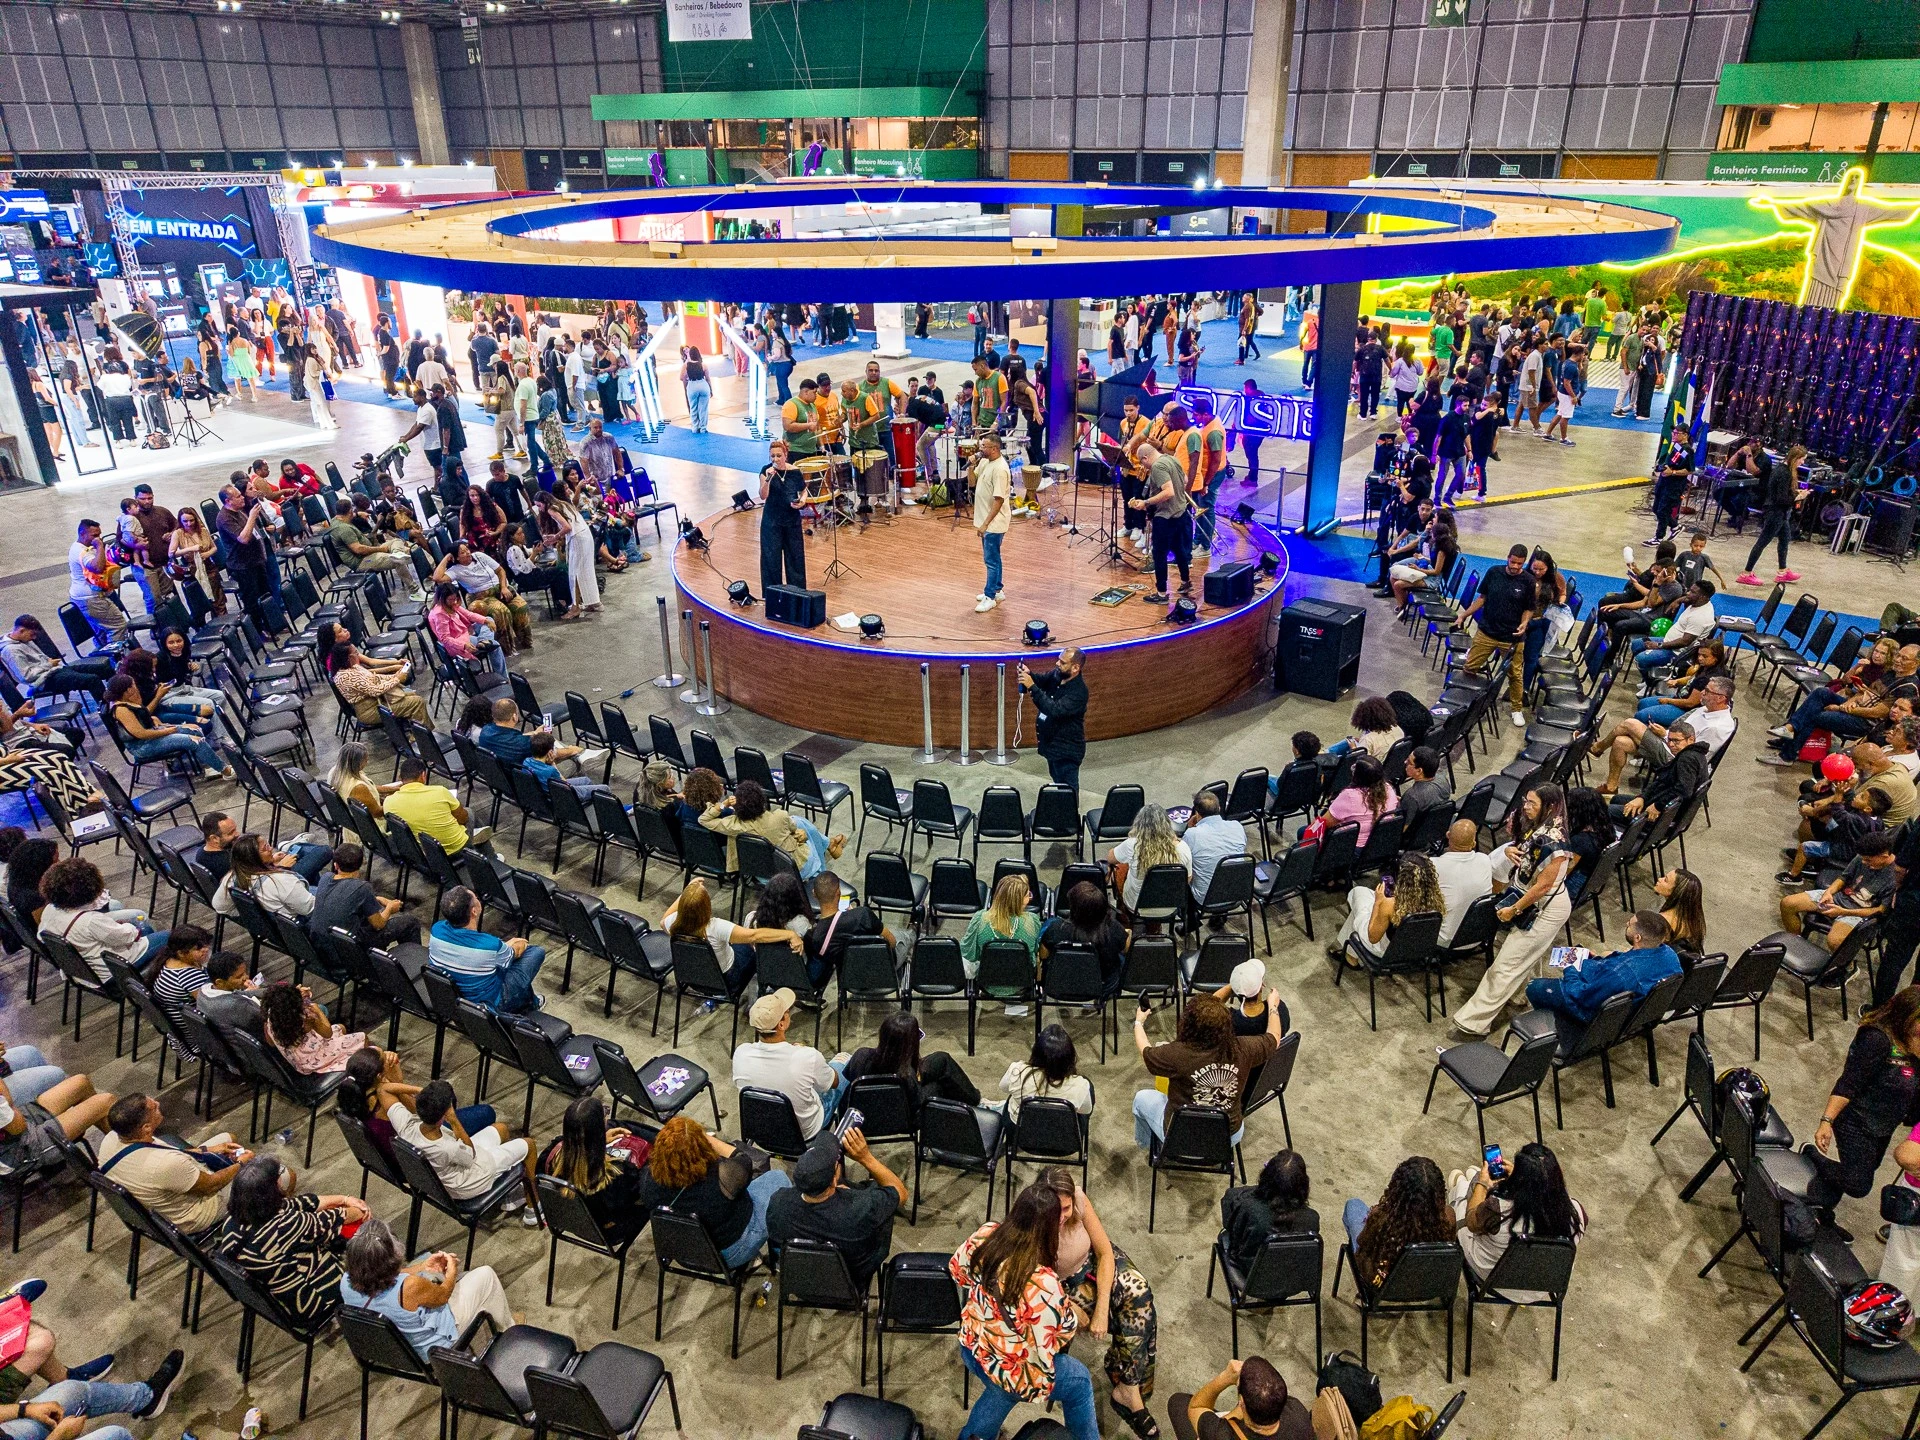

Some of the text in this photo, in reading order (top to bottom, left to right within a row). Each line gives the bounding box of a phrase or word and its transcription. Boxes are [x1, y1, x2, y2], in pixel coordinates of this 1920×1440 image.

[674, 3, 704, 11] Banheiros
[709, 1, 743, 9] Bebedouro
[1713, 165, 1808, 174] Banheiro Feminino
[156, 220, 239, 240] ENTRADA
[1190, 1062, 1240, 1082] Maraata
